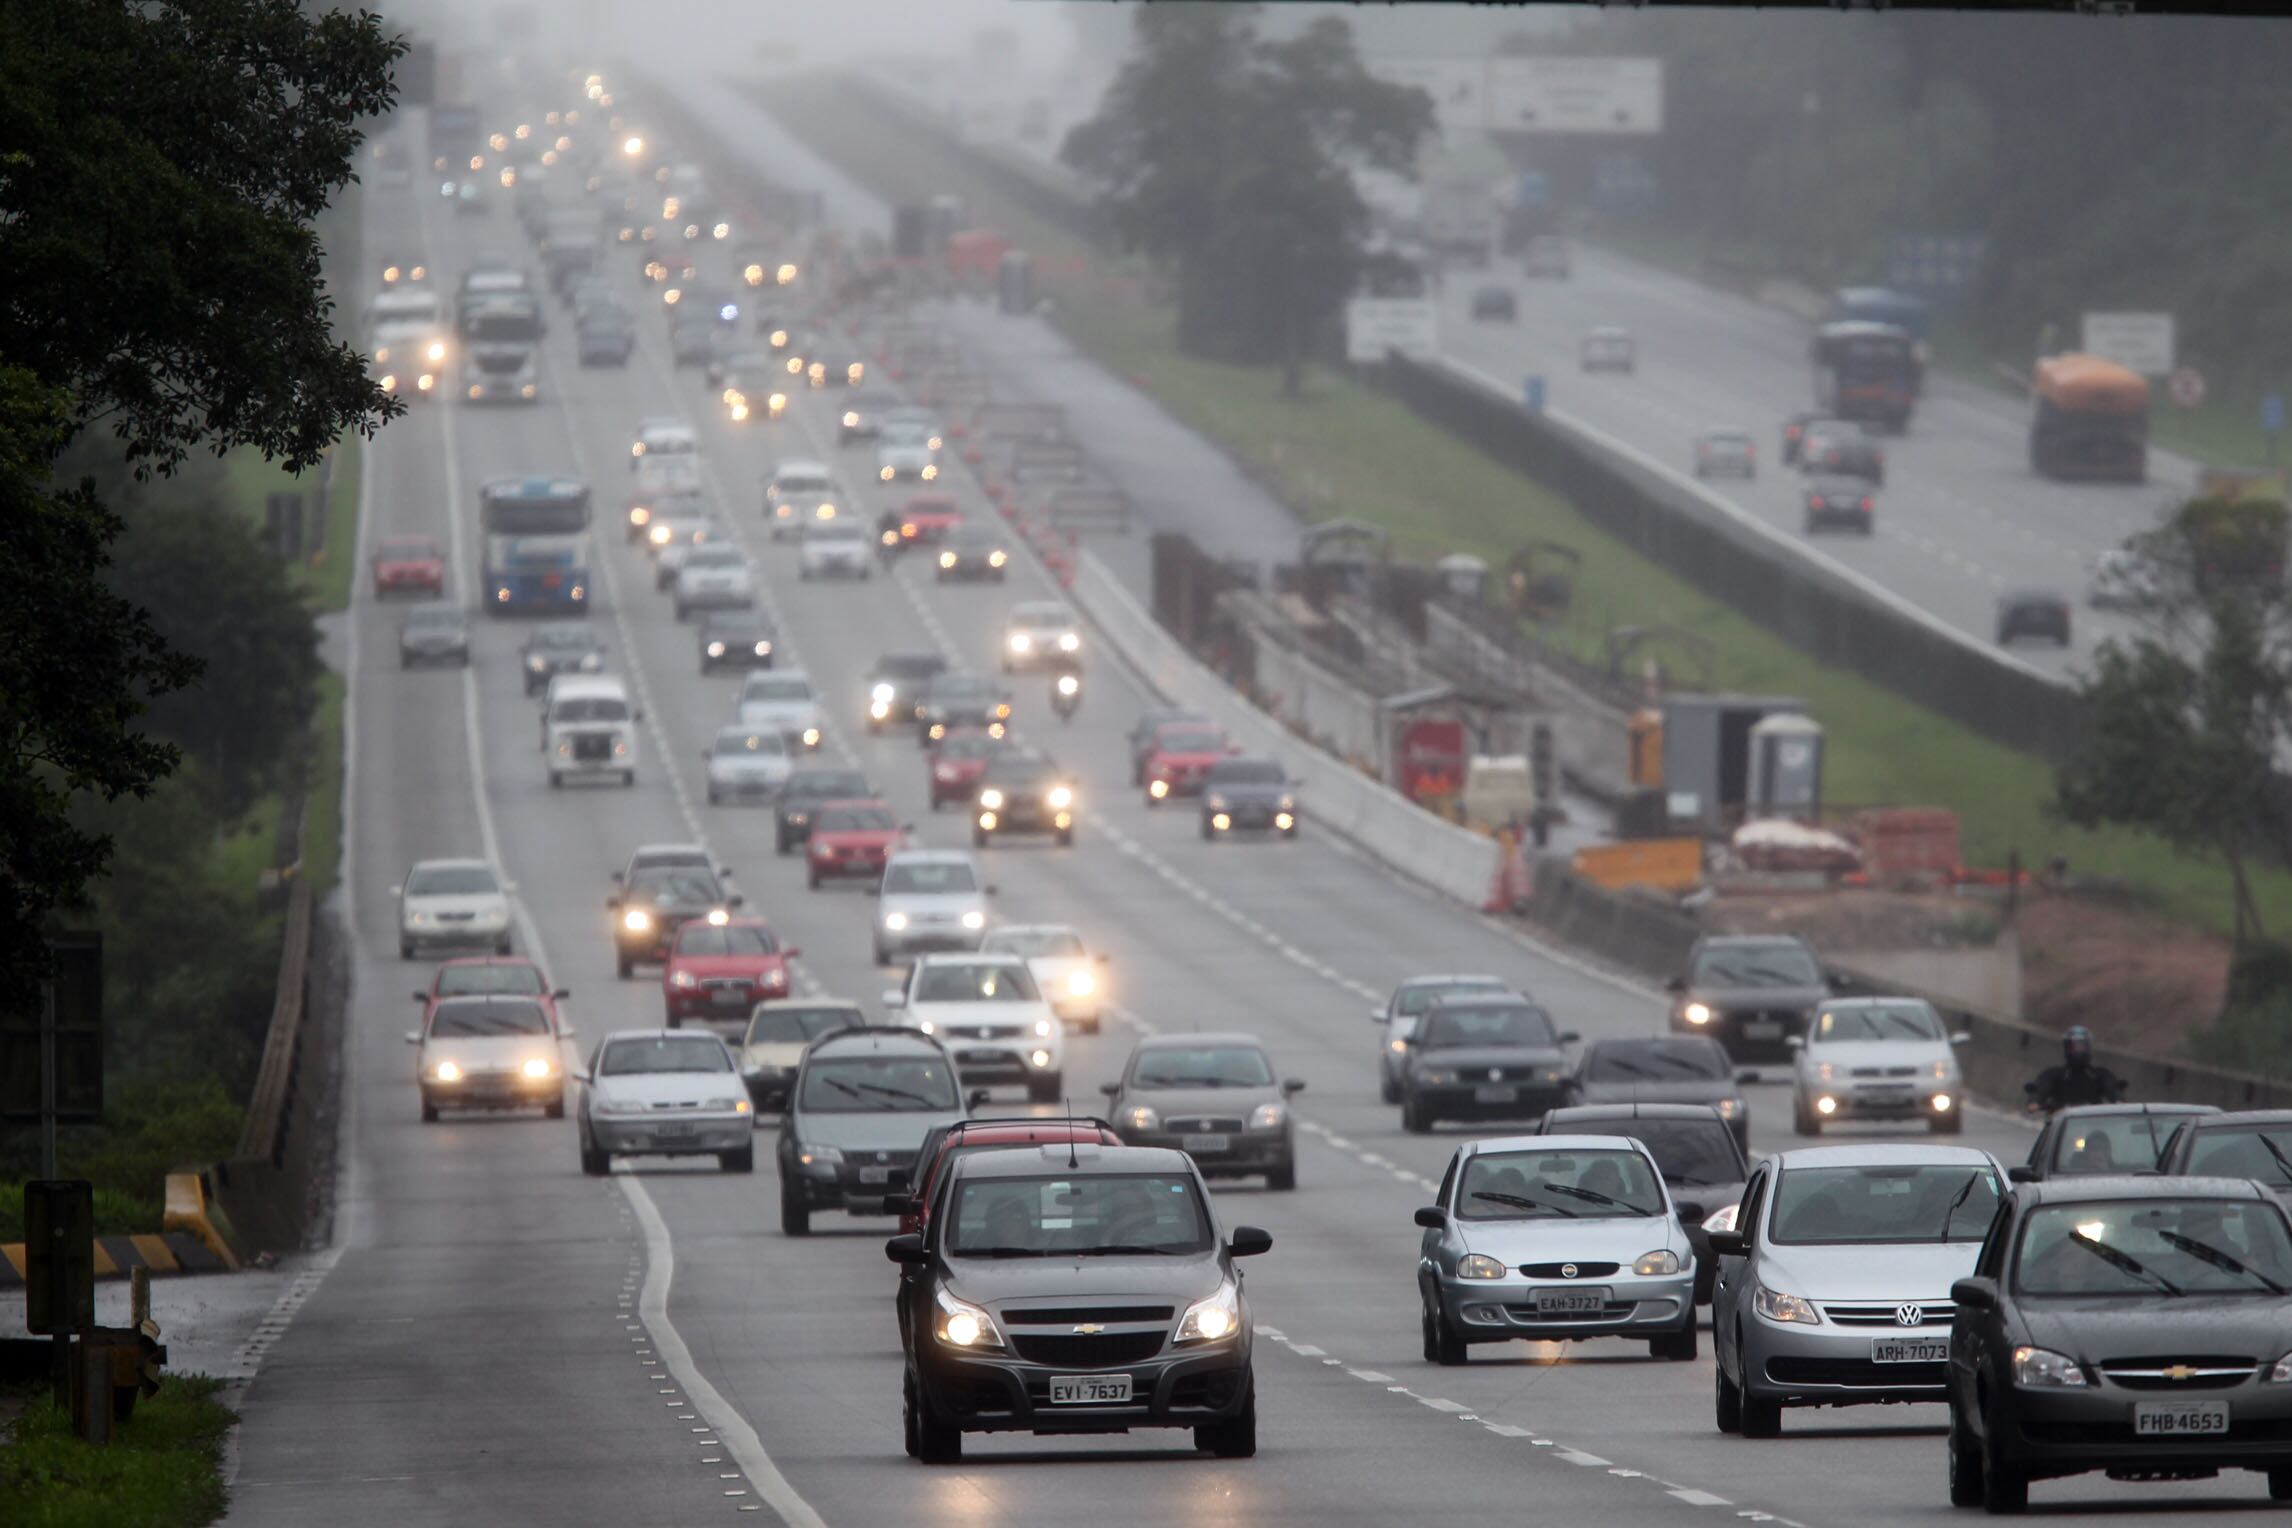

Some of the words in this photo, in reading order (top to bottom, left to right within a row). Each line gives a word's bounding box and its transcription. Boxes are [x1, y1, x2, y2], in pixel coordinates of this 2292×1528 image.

[1877, 1345, 1947, 1361] ARH-7073
[1054, 1384, 1127, 1400] EVI-7637
[2140, 1413, 2224, 1430] FHB-4653
